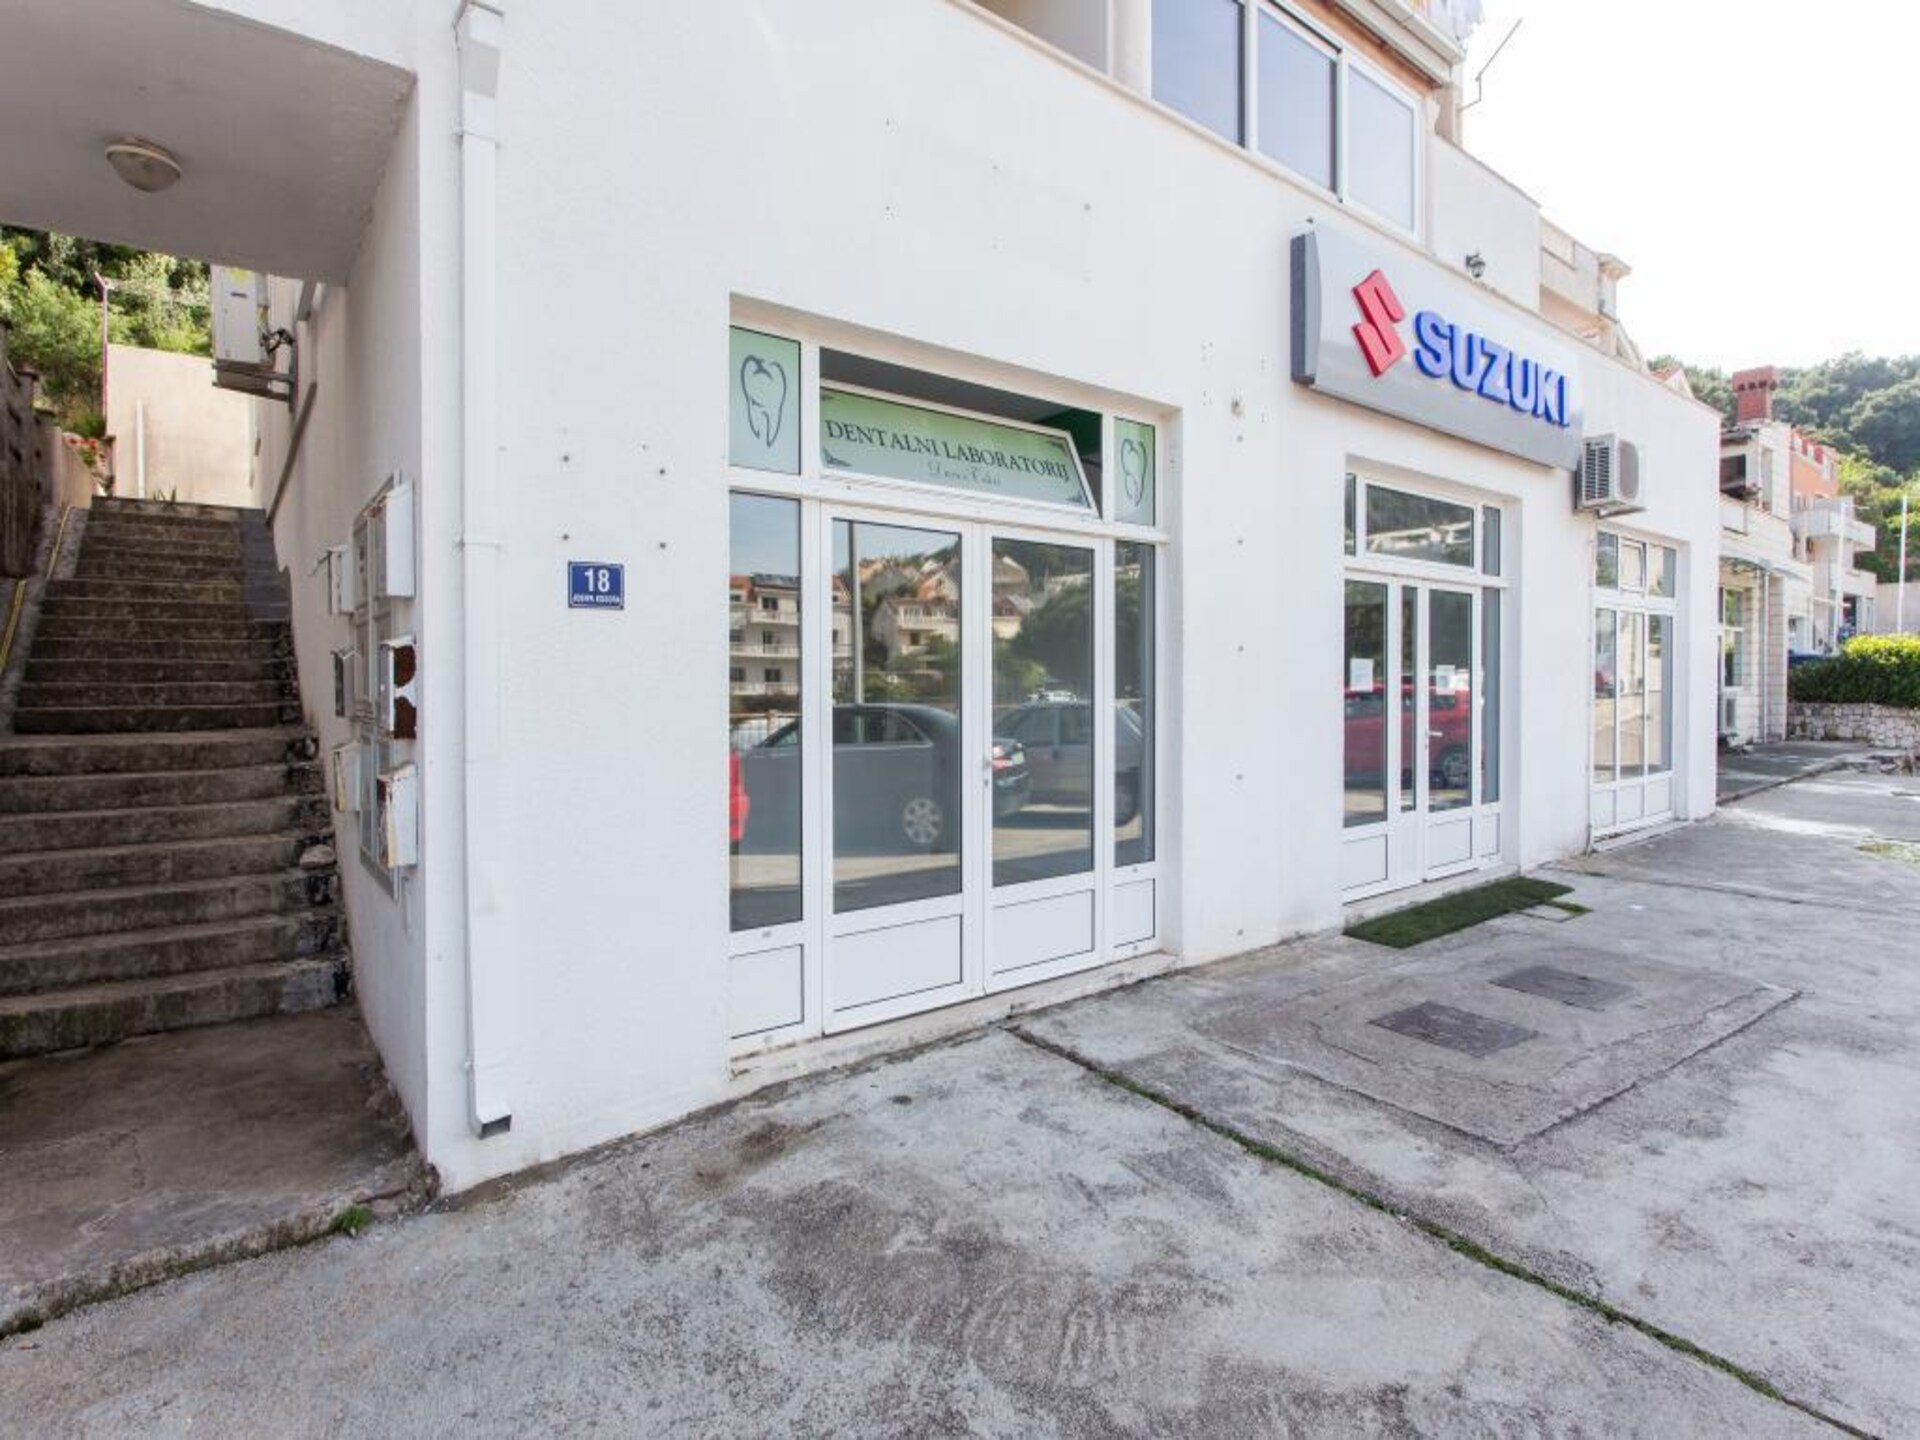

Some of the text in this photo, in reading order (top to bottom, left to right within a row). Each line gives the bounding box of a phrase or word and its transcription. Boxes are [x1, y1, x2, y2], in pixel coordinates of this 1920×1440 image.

[1413, 311, 1570, 428] SUZUKI
[824, 419, 940, 456] DENTALNI
[942, 441, 1069, 482] LABORATORIJ
[584, 568, 610, 593] 18
